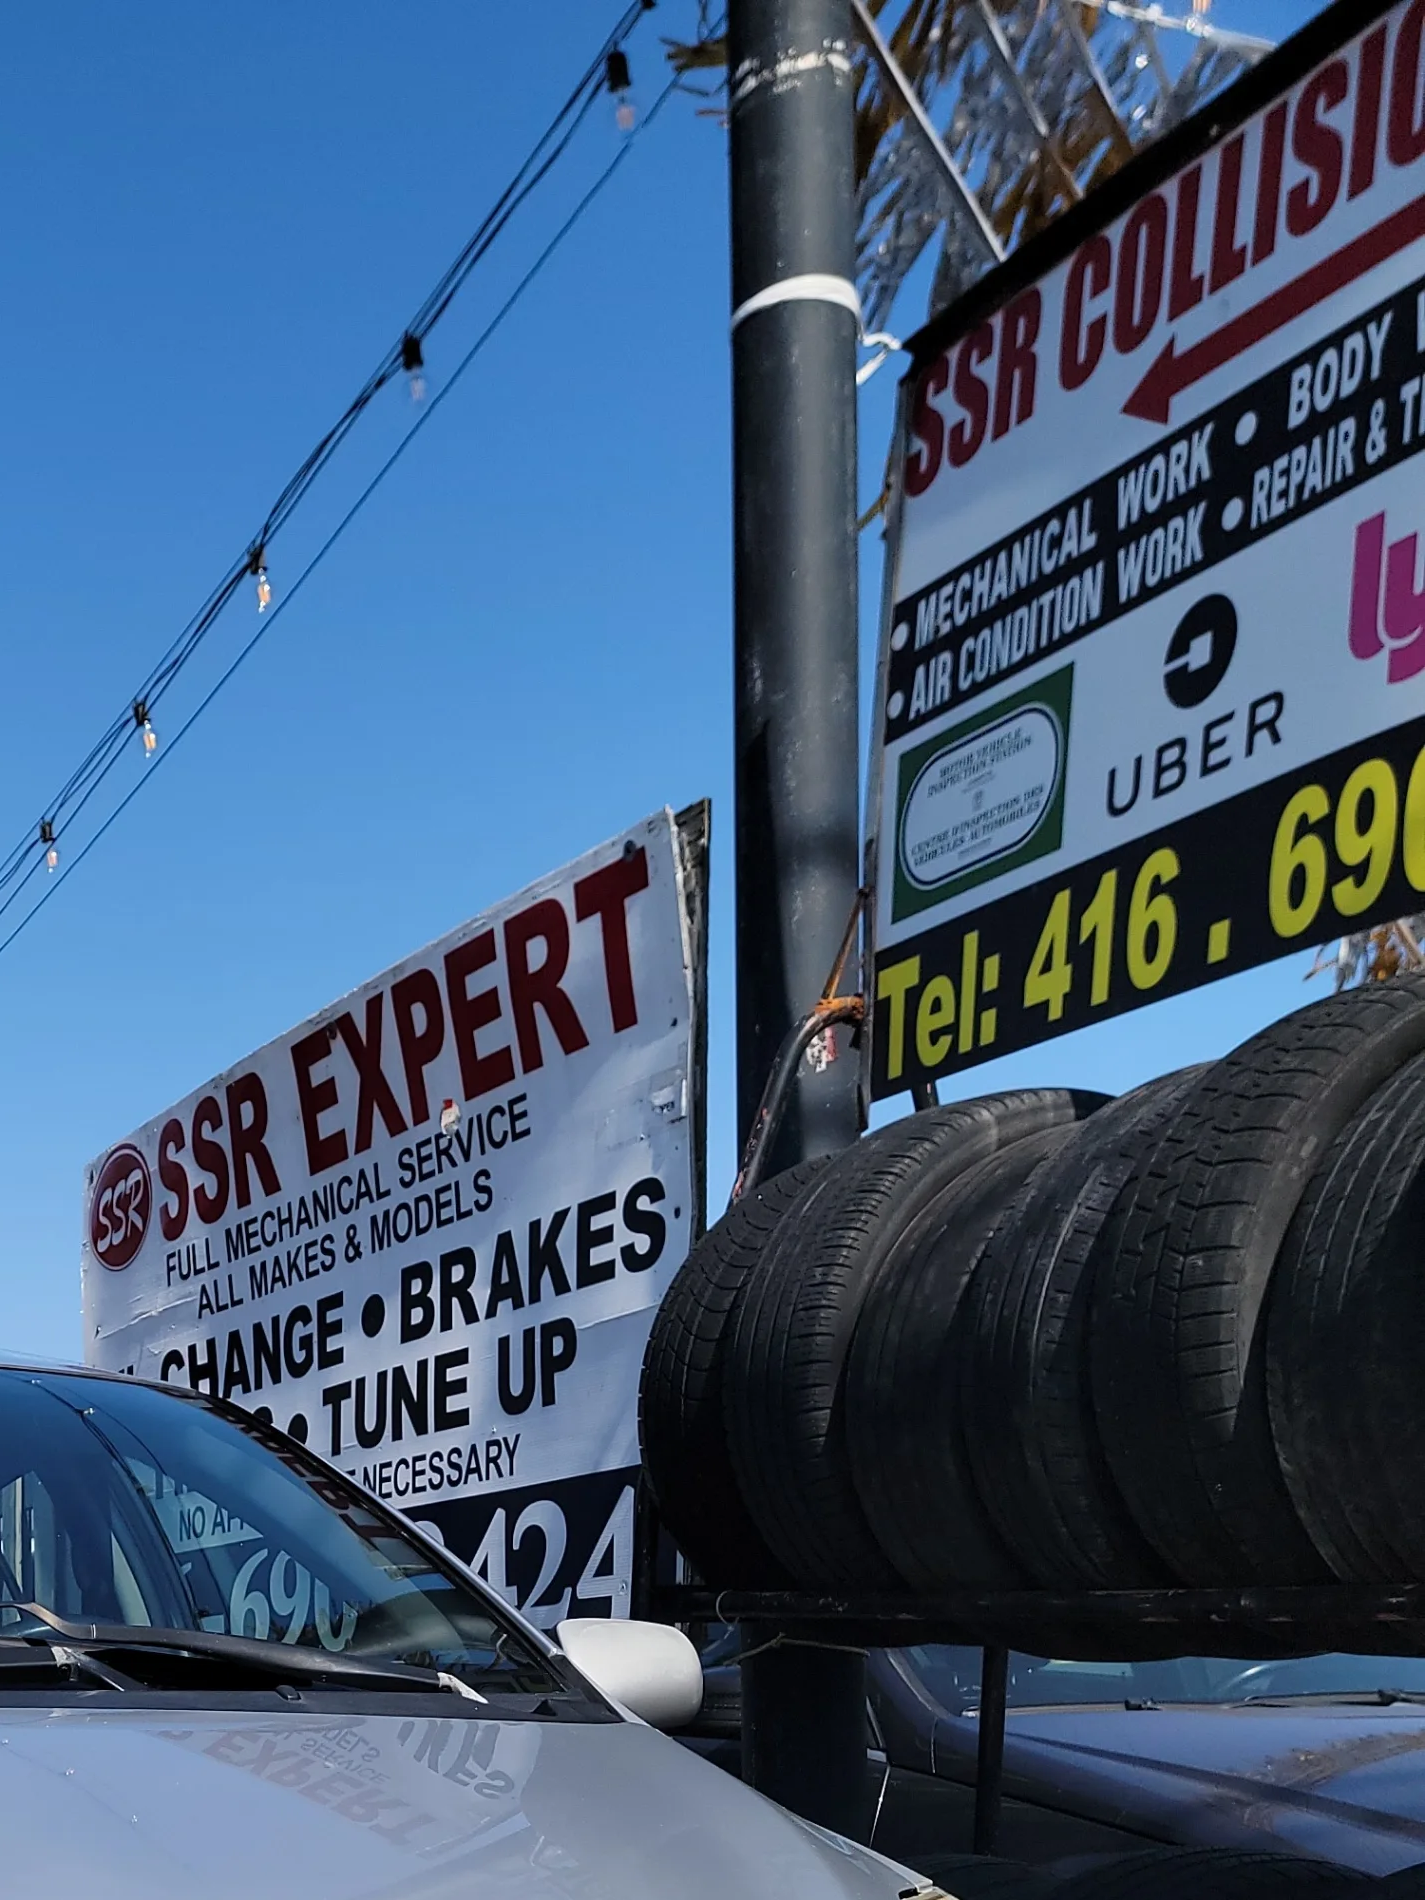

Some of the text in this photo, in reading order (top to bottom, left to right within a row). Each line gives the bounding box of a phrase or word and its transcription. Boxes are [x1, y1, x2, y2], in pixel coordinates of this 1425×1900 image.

[903, 287, 1042, 498] SSR
[914, 499, 1097, 650] MECHANICAL
[1116, 421, 1215, 531] WORK
[1287, 310, 1394, 431] BODY
[908, 652, 952, 721] AIR
[958, 562, 1104, 688] CONDITION
[1116, 502, 1204, 605] WORK
[1249, 416, 1356, 528] REPAIR
[1364, 398, 1388, 466] &
[1106, 690, 1285, 818] UBER
[157, 846, 650, 1241] SSR EXPERT
[878, 930, 1001, 1081] Tel:
[1023, 847, 1182, 1023] 416
[93, 1164, 148, 1254] SSR
[165, 1092, 531, 1288] FULL MECHANICAL SERVICE
[197, 1168, 495, 1320] ALL MAKES & MODELS
[399, 1176, 668, 1345] BRAKES
[321, 1316, 578, 1458] TUNE UP
[179, 1505, 207, 1543] NO
